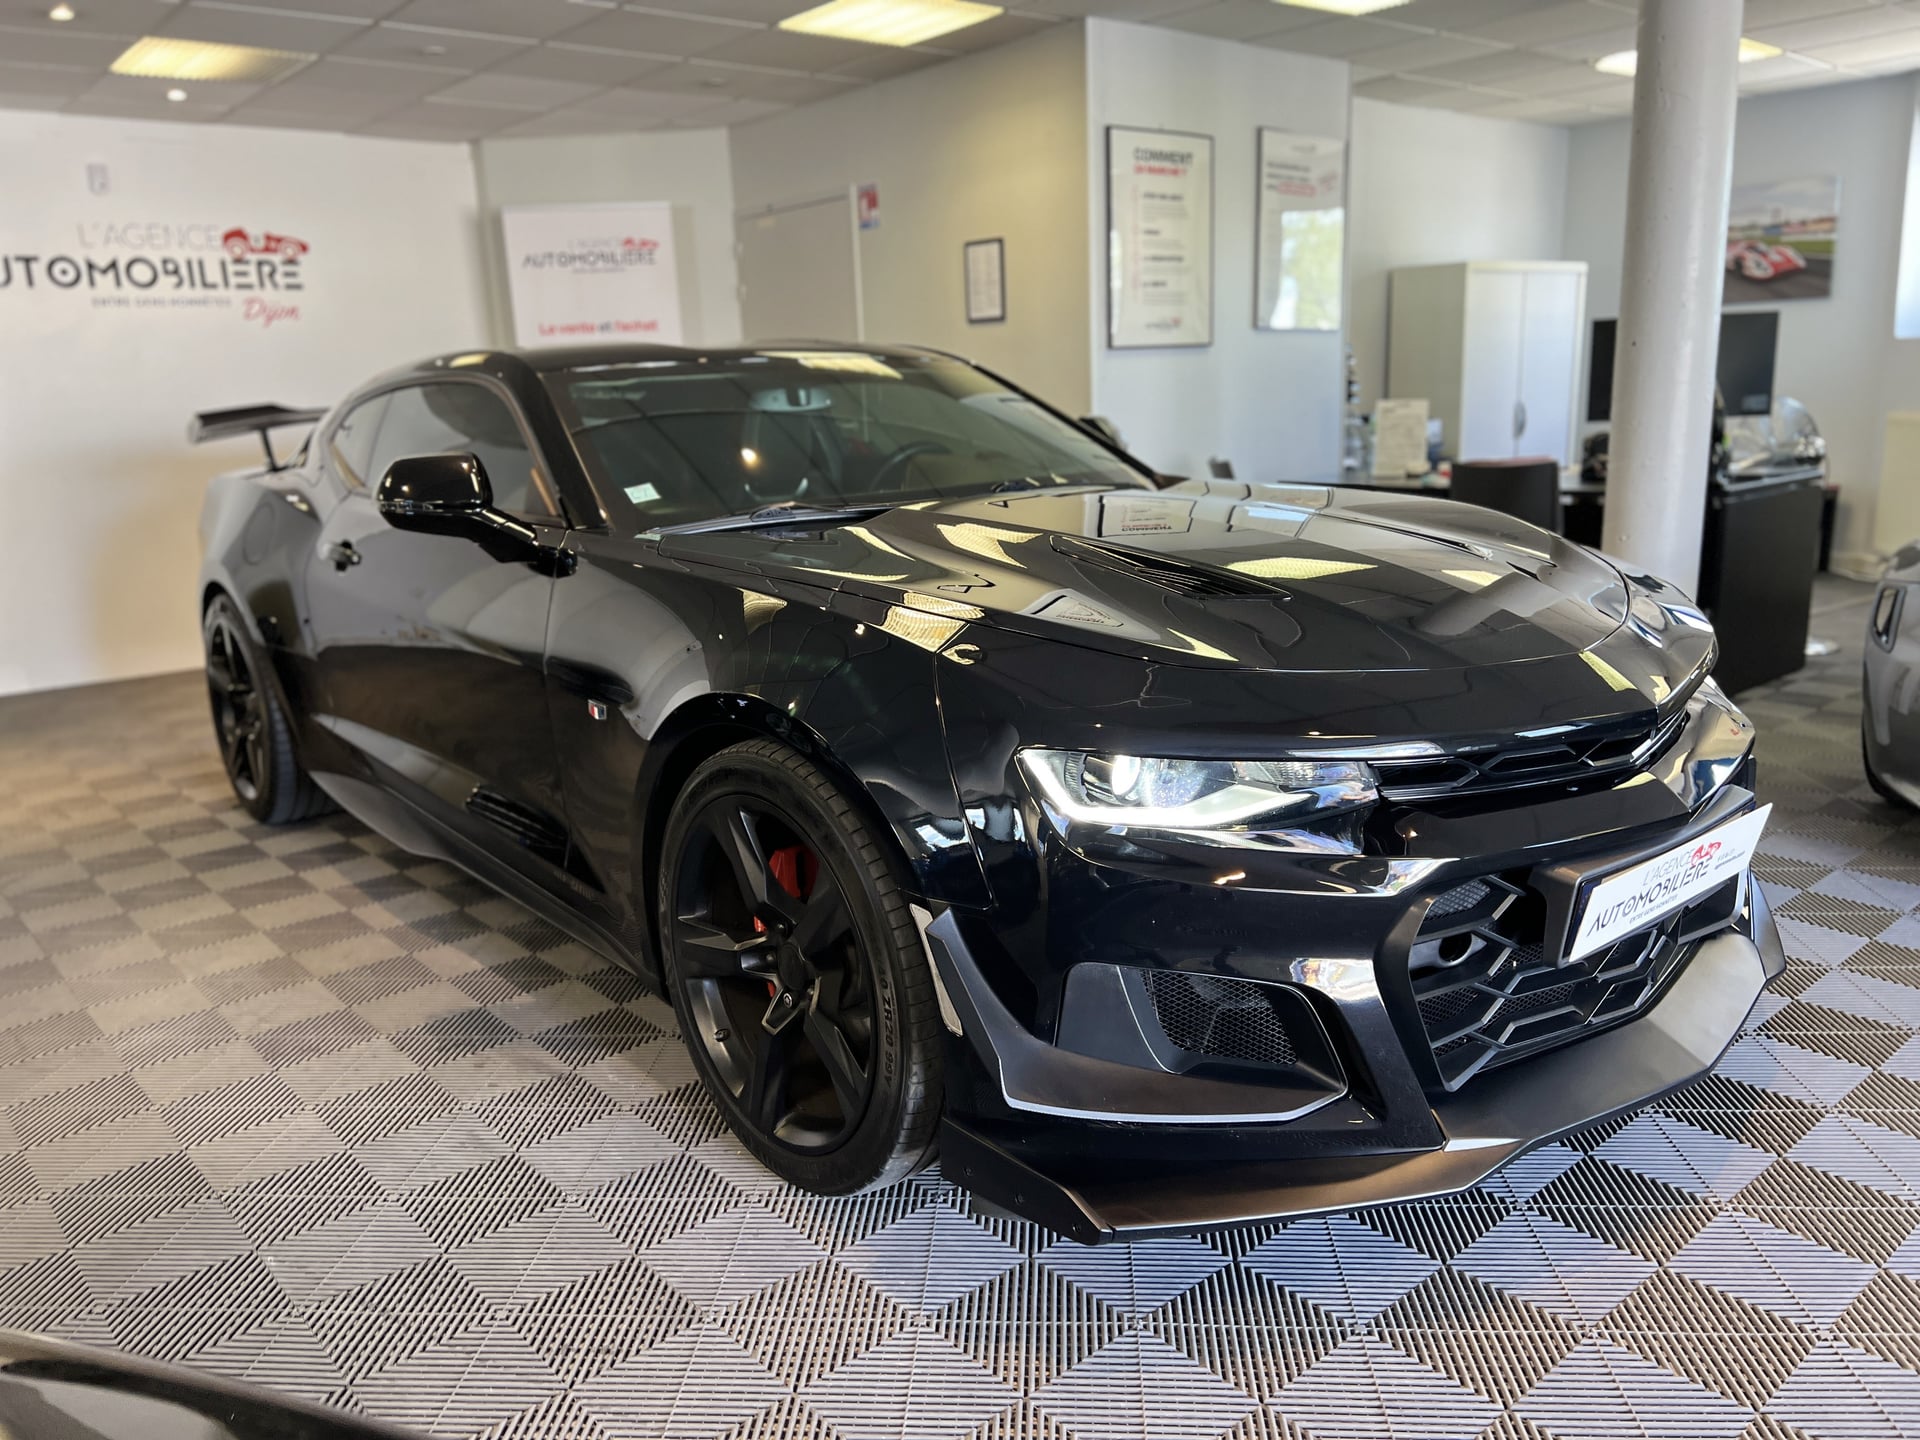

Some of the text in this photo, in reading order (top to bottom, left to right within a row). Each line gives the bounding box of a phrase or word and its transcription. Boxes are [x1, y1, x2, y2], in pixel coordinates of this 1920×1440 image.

[76, 222, 221, 250] L'AGENCE
[0, 254, 304, 290] UTOMOBILIERE
[1643, 848, 1696, 886] L'AGENCE
[1587, 855, 1712, 937] AUTOMOBILIERE
